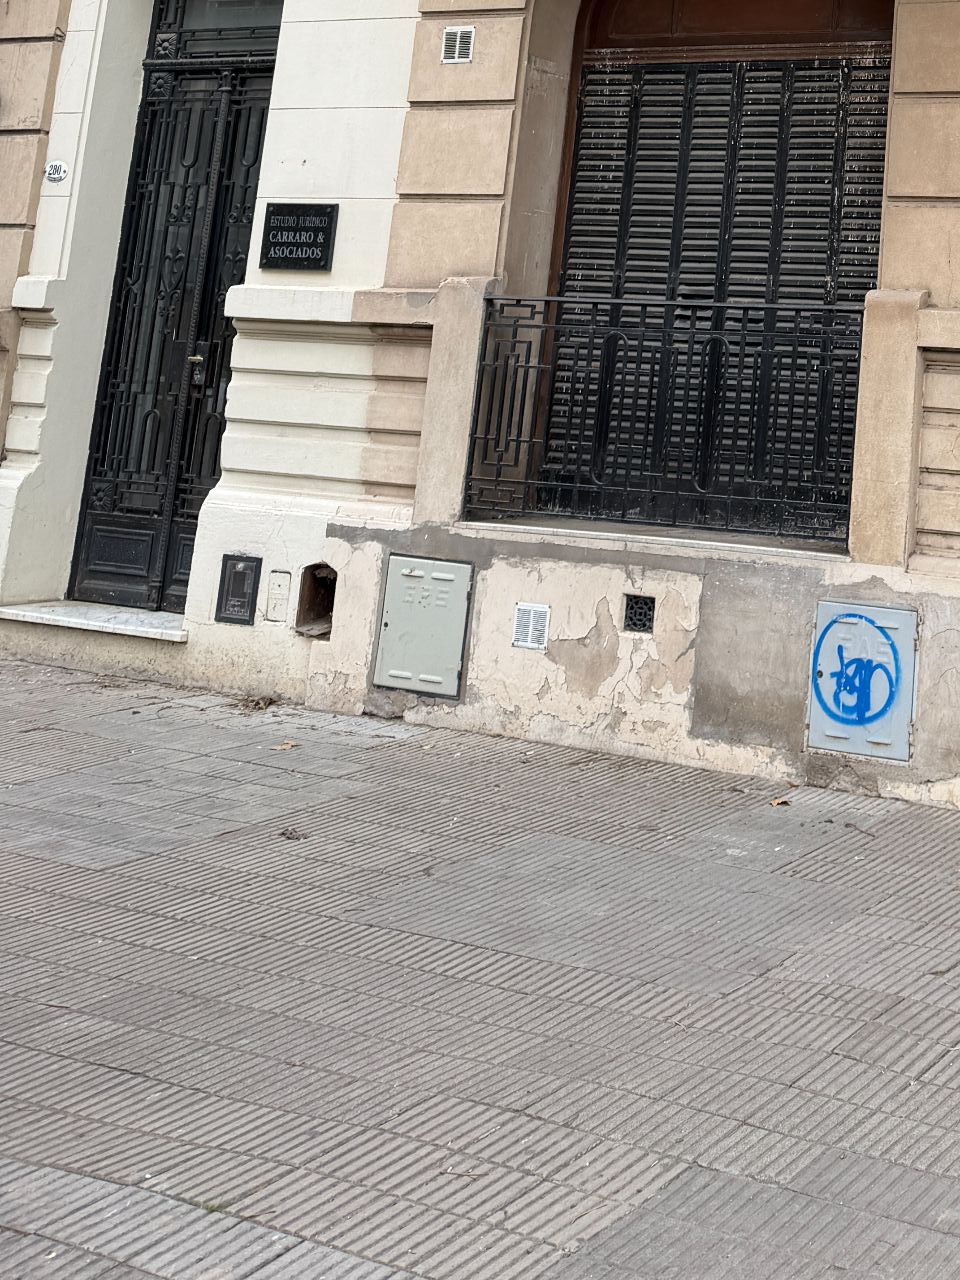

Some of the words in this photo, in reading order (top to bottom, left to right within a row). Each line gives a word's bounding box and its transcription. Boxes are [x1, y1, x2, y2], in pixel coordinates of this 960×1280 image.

[47, 164, 62, 176] 280
[270, 215, 297, 227] ESTUDIO
[298, 215, 328, 228] JURÍDICO
[269, 230, 314, 243] CARRARO
[317, 231, 325, 243] &
[268, 246, 322, 259] ASOCIADOS
